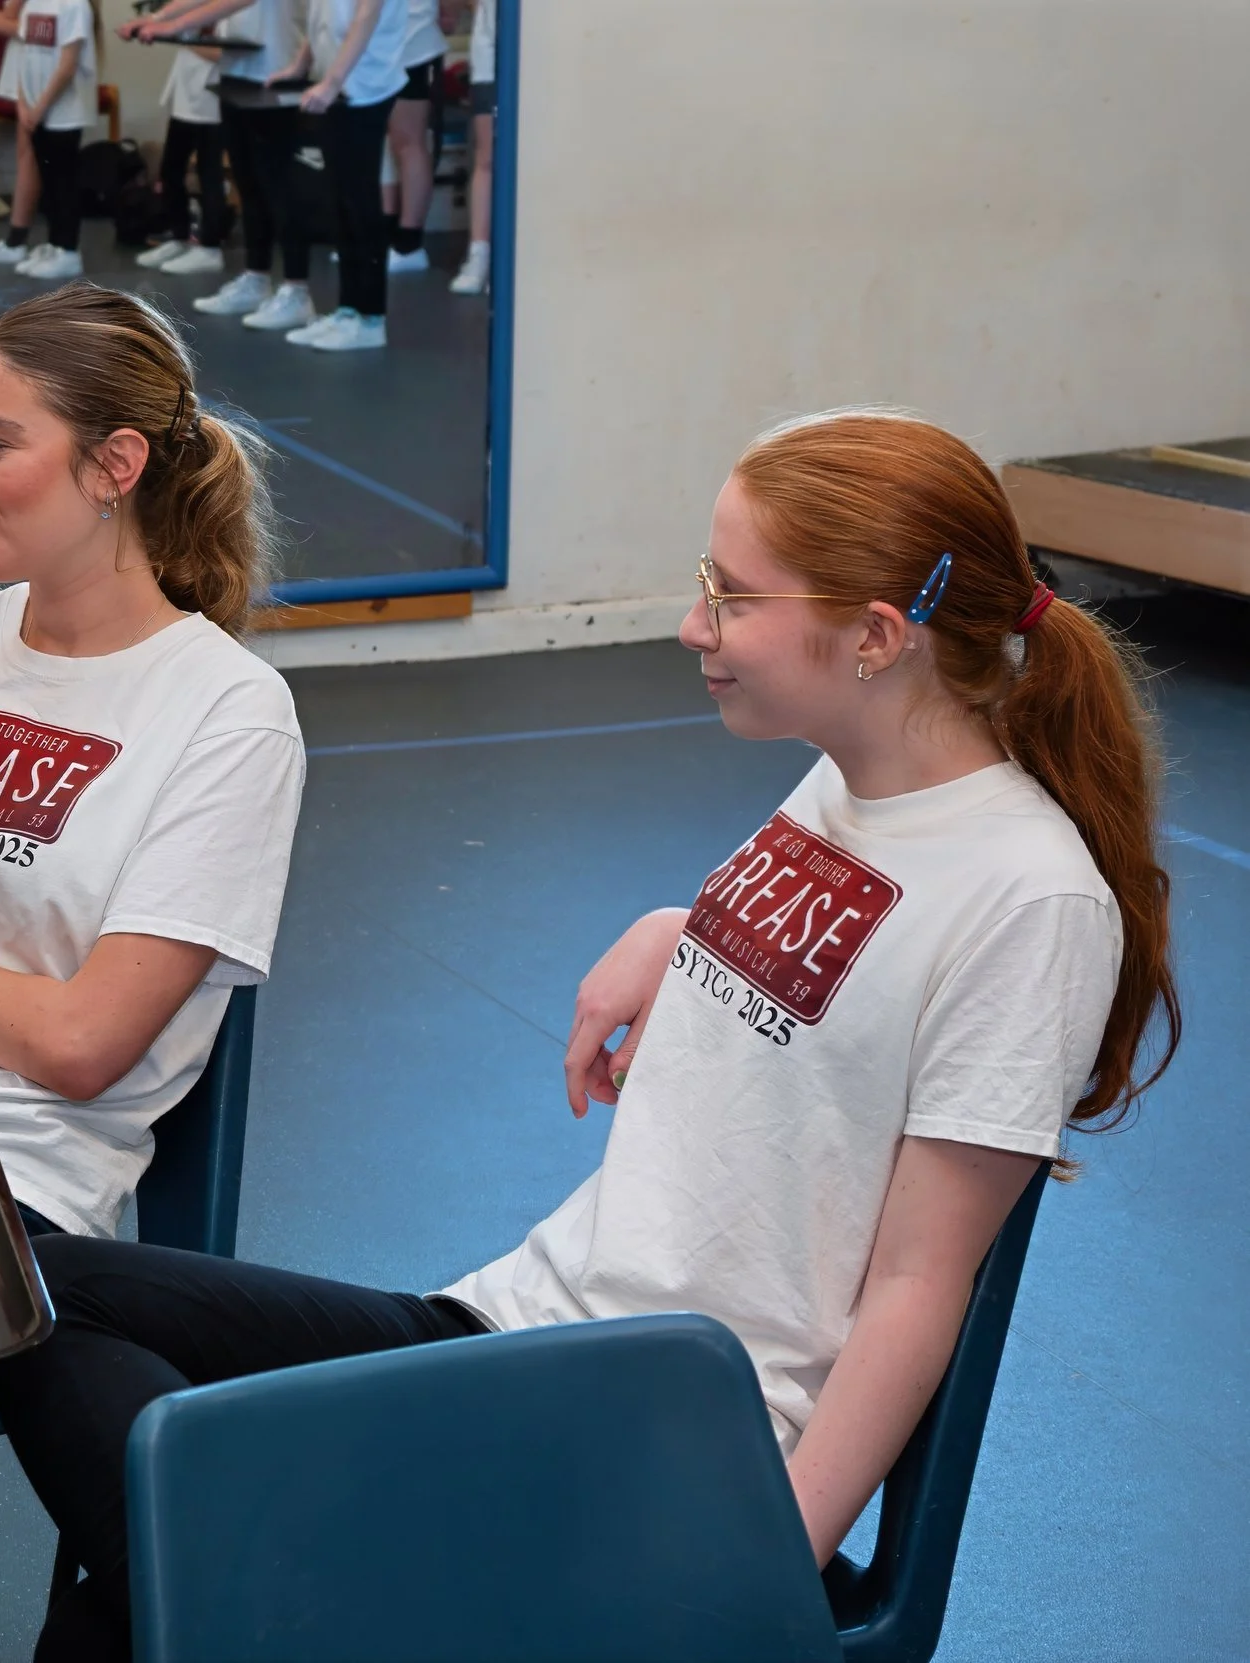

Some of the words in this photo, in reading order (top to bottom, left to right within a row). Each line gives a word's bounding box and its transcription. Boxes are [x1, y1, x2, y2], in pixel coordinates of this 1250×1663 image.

[27, 812, 48, 829] 59
[774, 832, 792, 849] WE
[786, 840, 806, 859] GO
[804, 849, 853, 889] TOGETHER
[671, 941, 735, 1006] SYTCo
[737, 988, 800, 1047] 2025
[693, 910, 722, 938] THE
[720, 928, 781, 982] MUSICAL
[787, 977, 813, 1003] 59
